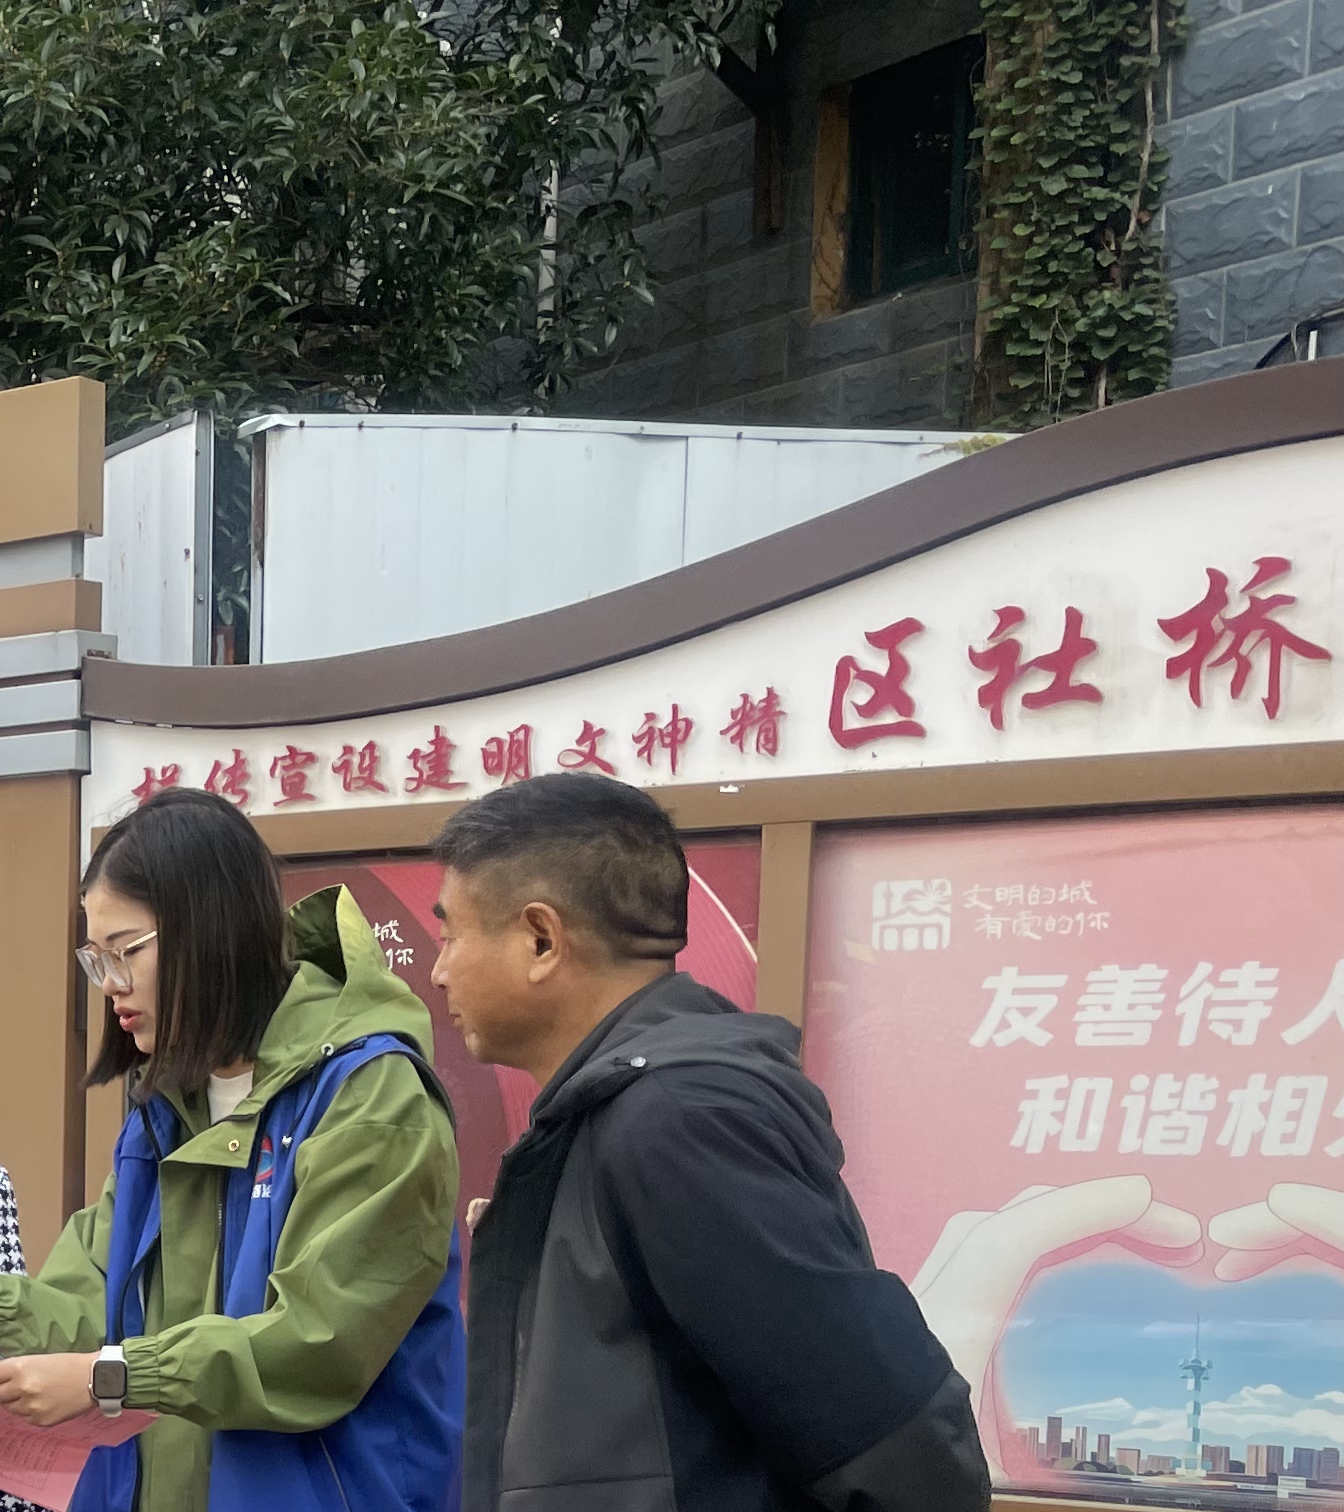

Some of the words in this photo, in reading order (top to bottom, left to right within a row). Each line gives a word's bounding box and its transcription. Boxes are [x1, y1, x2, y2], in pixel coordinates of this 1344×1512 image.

[962, 881, 1098, 910] 文明的城
[968, 959, 1344, 1047] 友善待人
[1010, 1073, 1344, 1157] 和谐相
